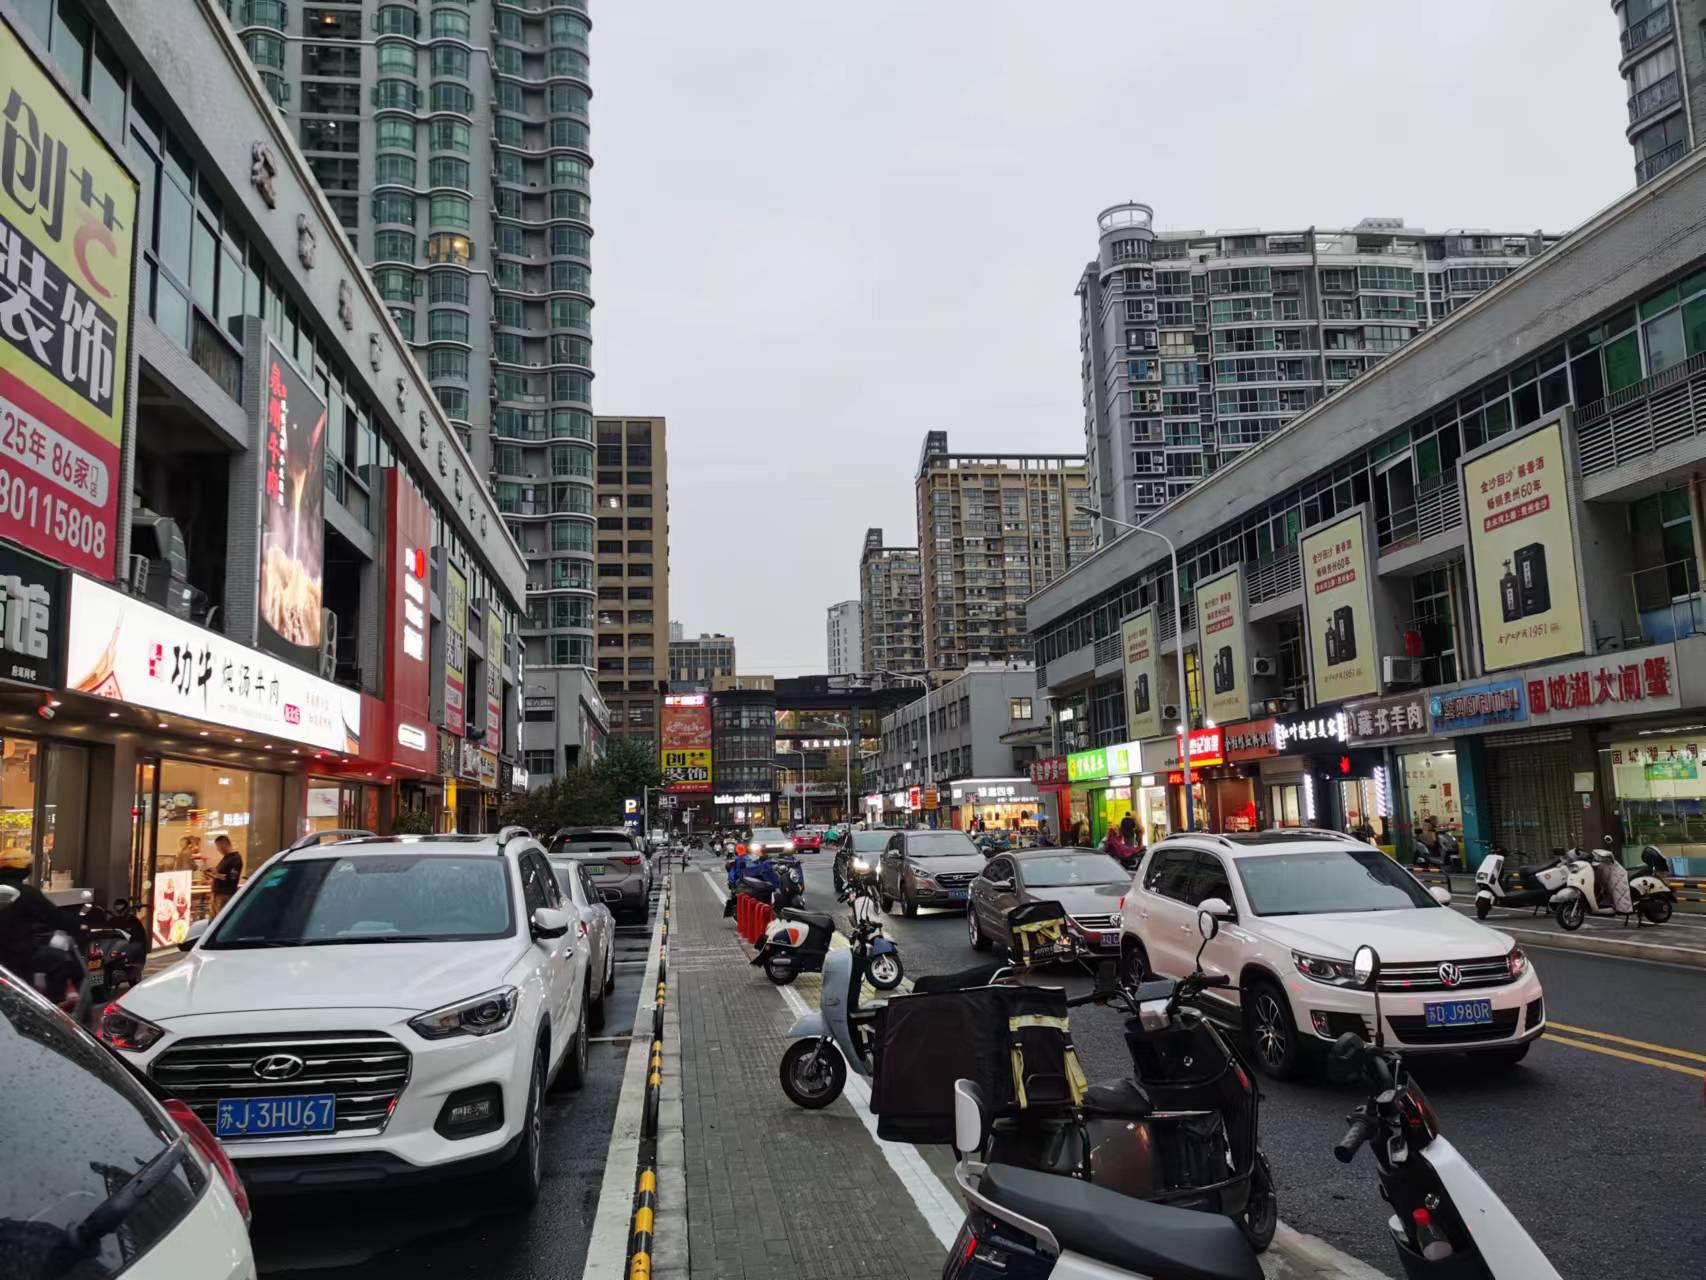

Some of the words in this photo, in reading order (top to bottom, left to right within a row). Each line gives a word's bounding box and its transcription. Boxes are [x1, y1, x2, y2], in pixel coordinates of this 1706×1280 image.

[2, 87, 124, 299] 创艺
[3, 411, 46, 464] 25年
[0, 575, 50, 659] 馆
[1528, 655, 1671, 714] 固城湖大闸蟹
[1357, 702, 1424, 736] 藏书羊肉
[625, 799, 637, 813] P
